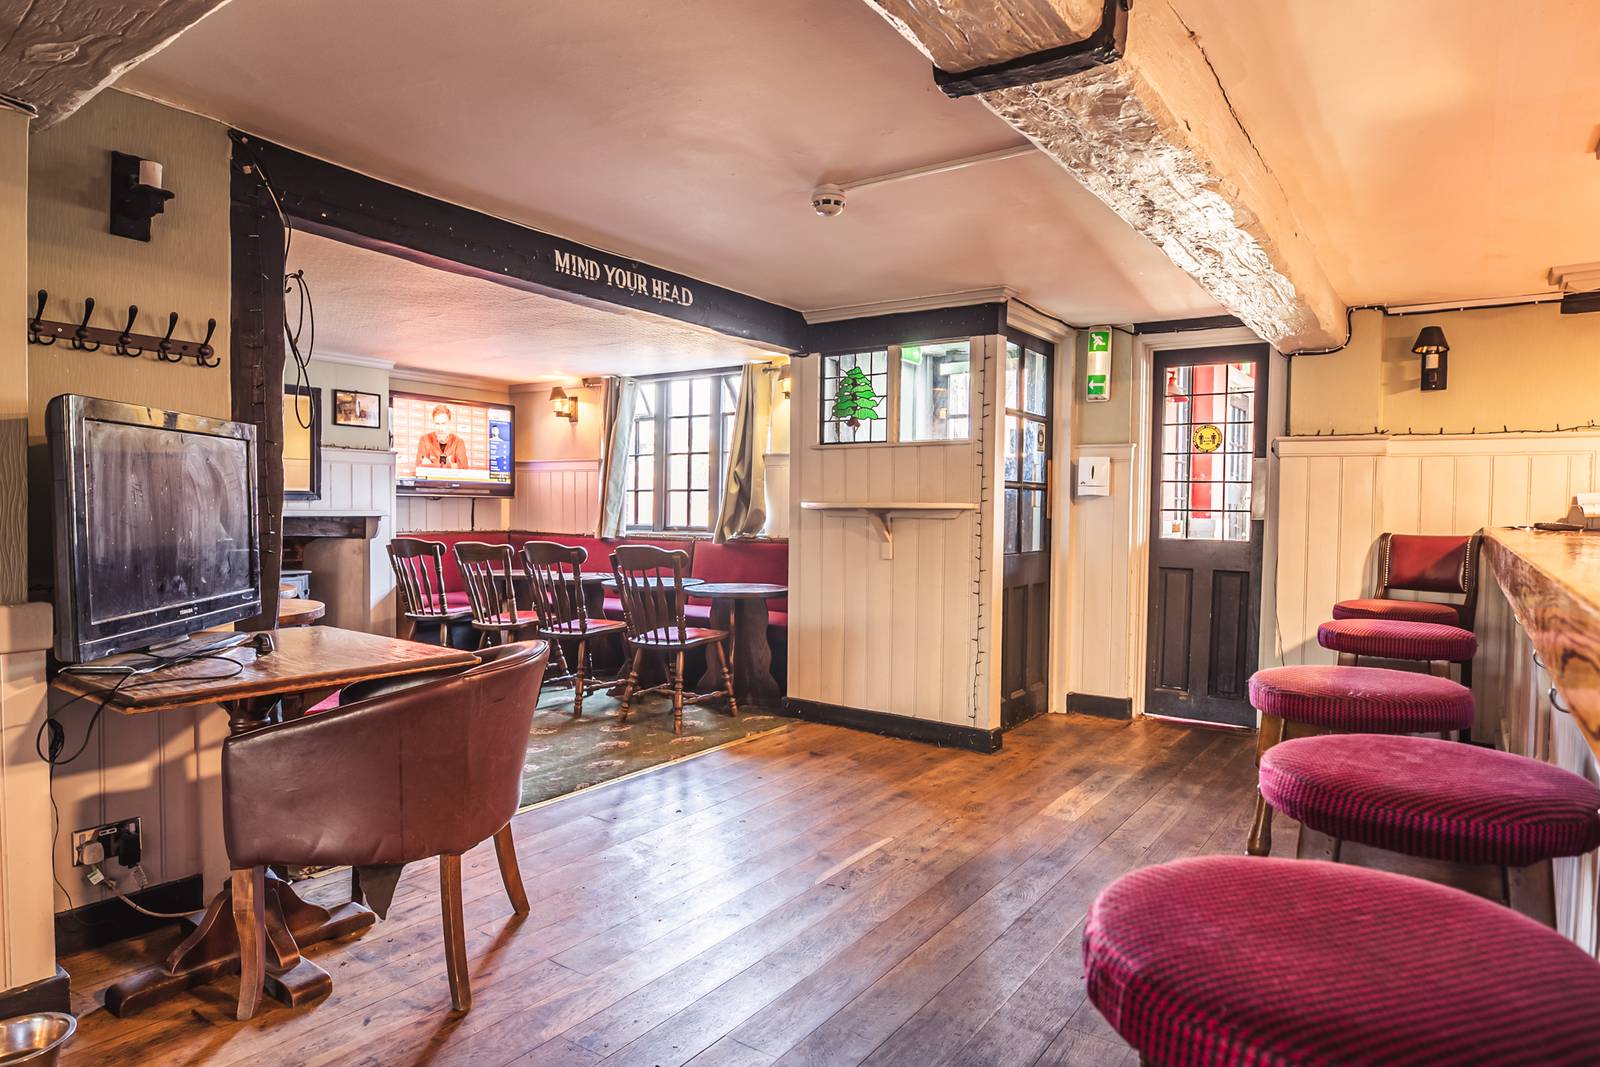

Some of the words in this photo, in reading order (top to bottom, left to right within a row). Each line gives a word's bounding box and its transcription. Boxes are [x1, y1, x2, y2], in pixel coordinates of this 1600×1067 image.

[553, 249, 601, 281] MIND
[602, 264, 649, 296] YOUR
[651, 278, 694, 307] HEAD
